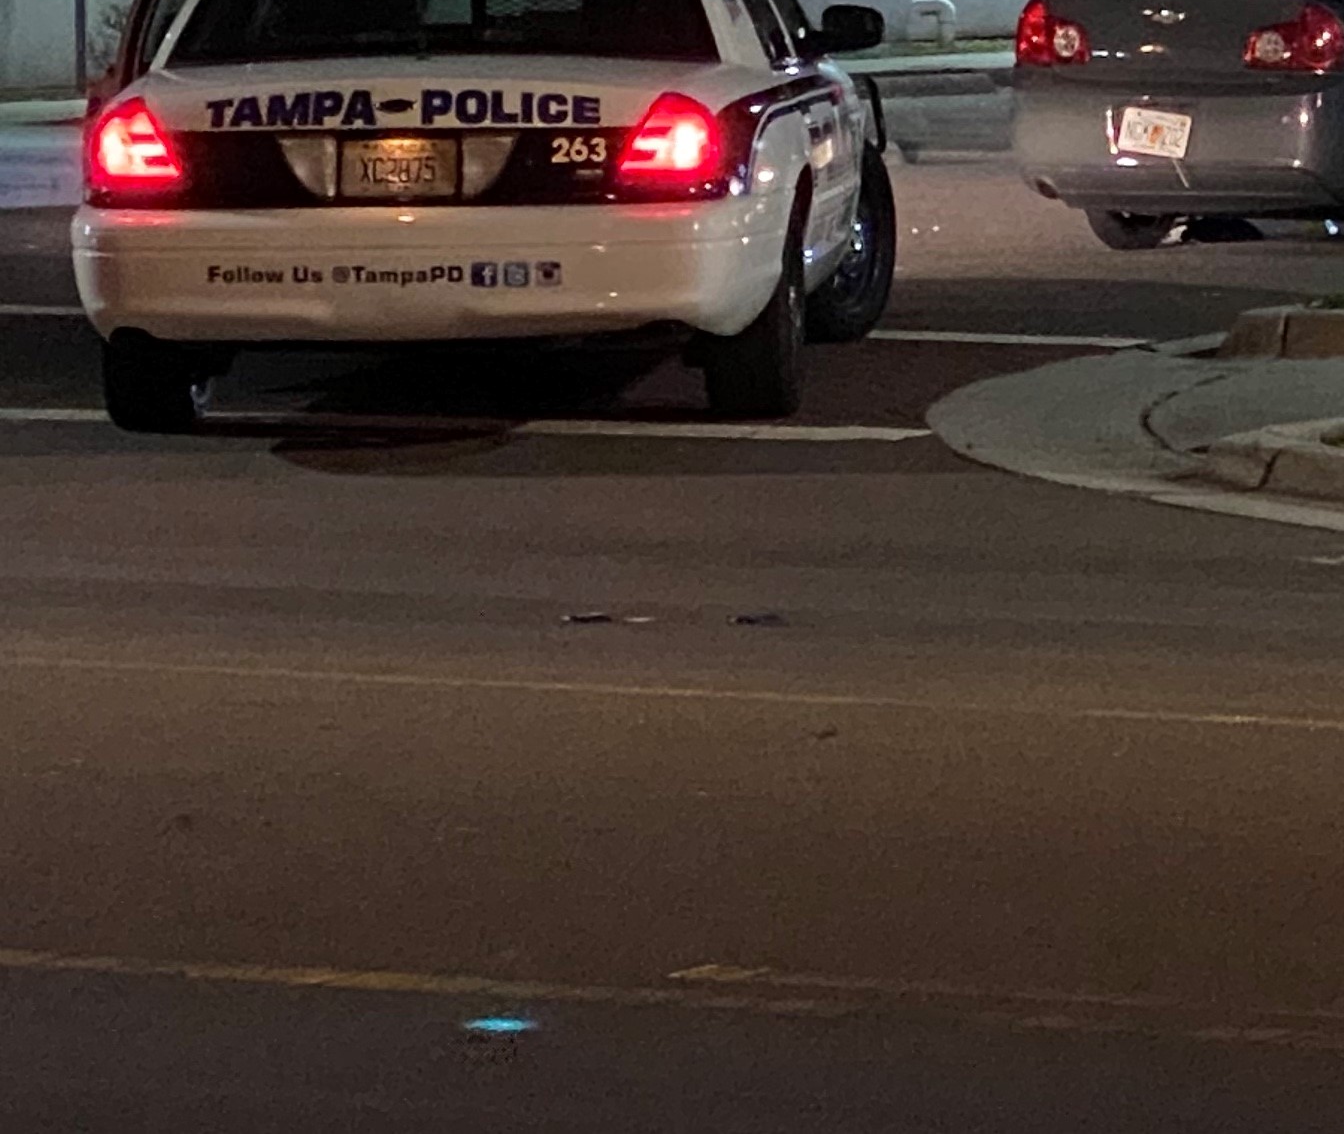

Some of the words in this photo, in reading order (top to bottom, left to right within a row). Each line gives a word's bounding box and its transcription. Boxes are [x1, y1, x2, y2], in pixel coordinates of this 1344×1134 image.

[207, 90, 377, 127] TAMPA
[420, 89, 601, 125] POLICE
[551, 137, 607, 163] 263
[207, 267, 284, 284] Follow
[291, 267, 323, 284] Us
[332, 266, 464, 286] @TampaPD
